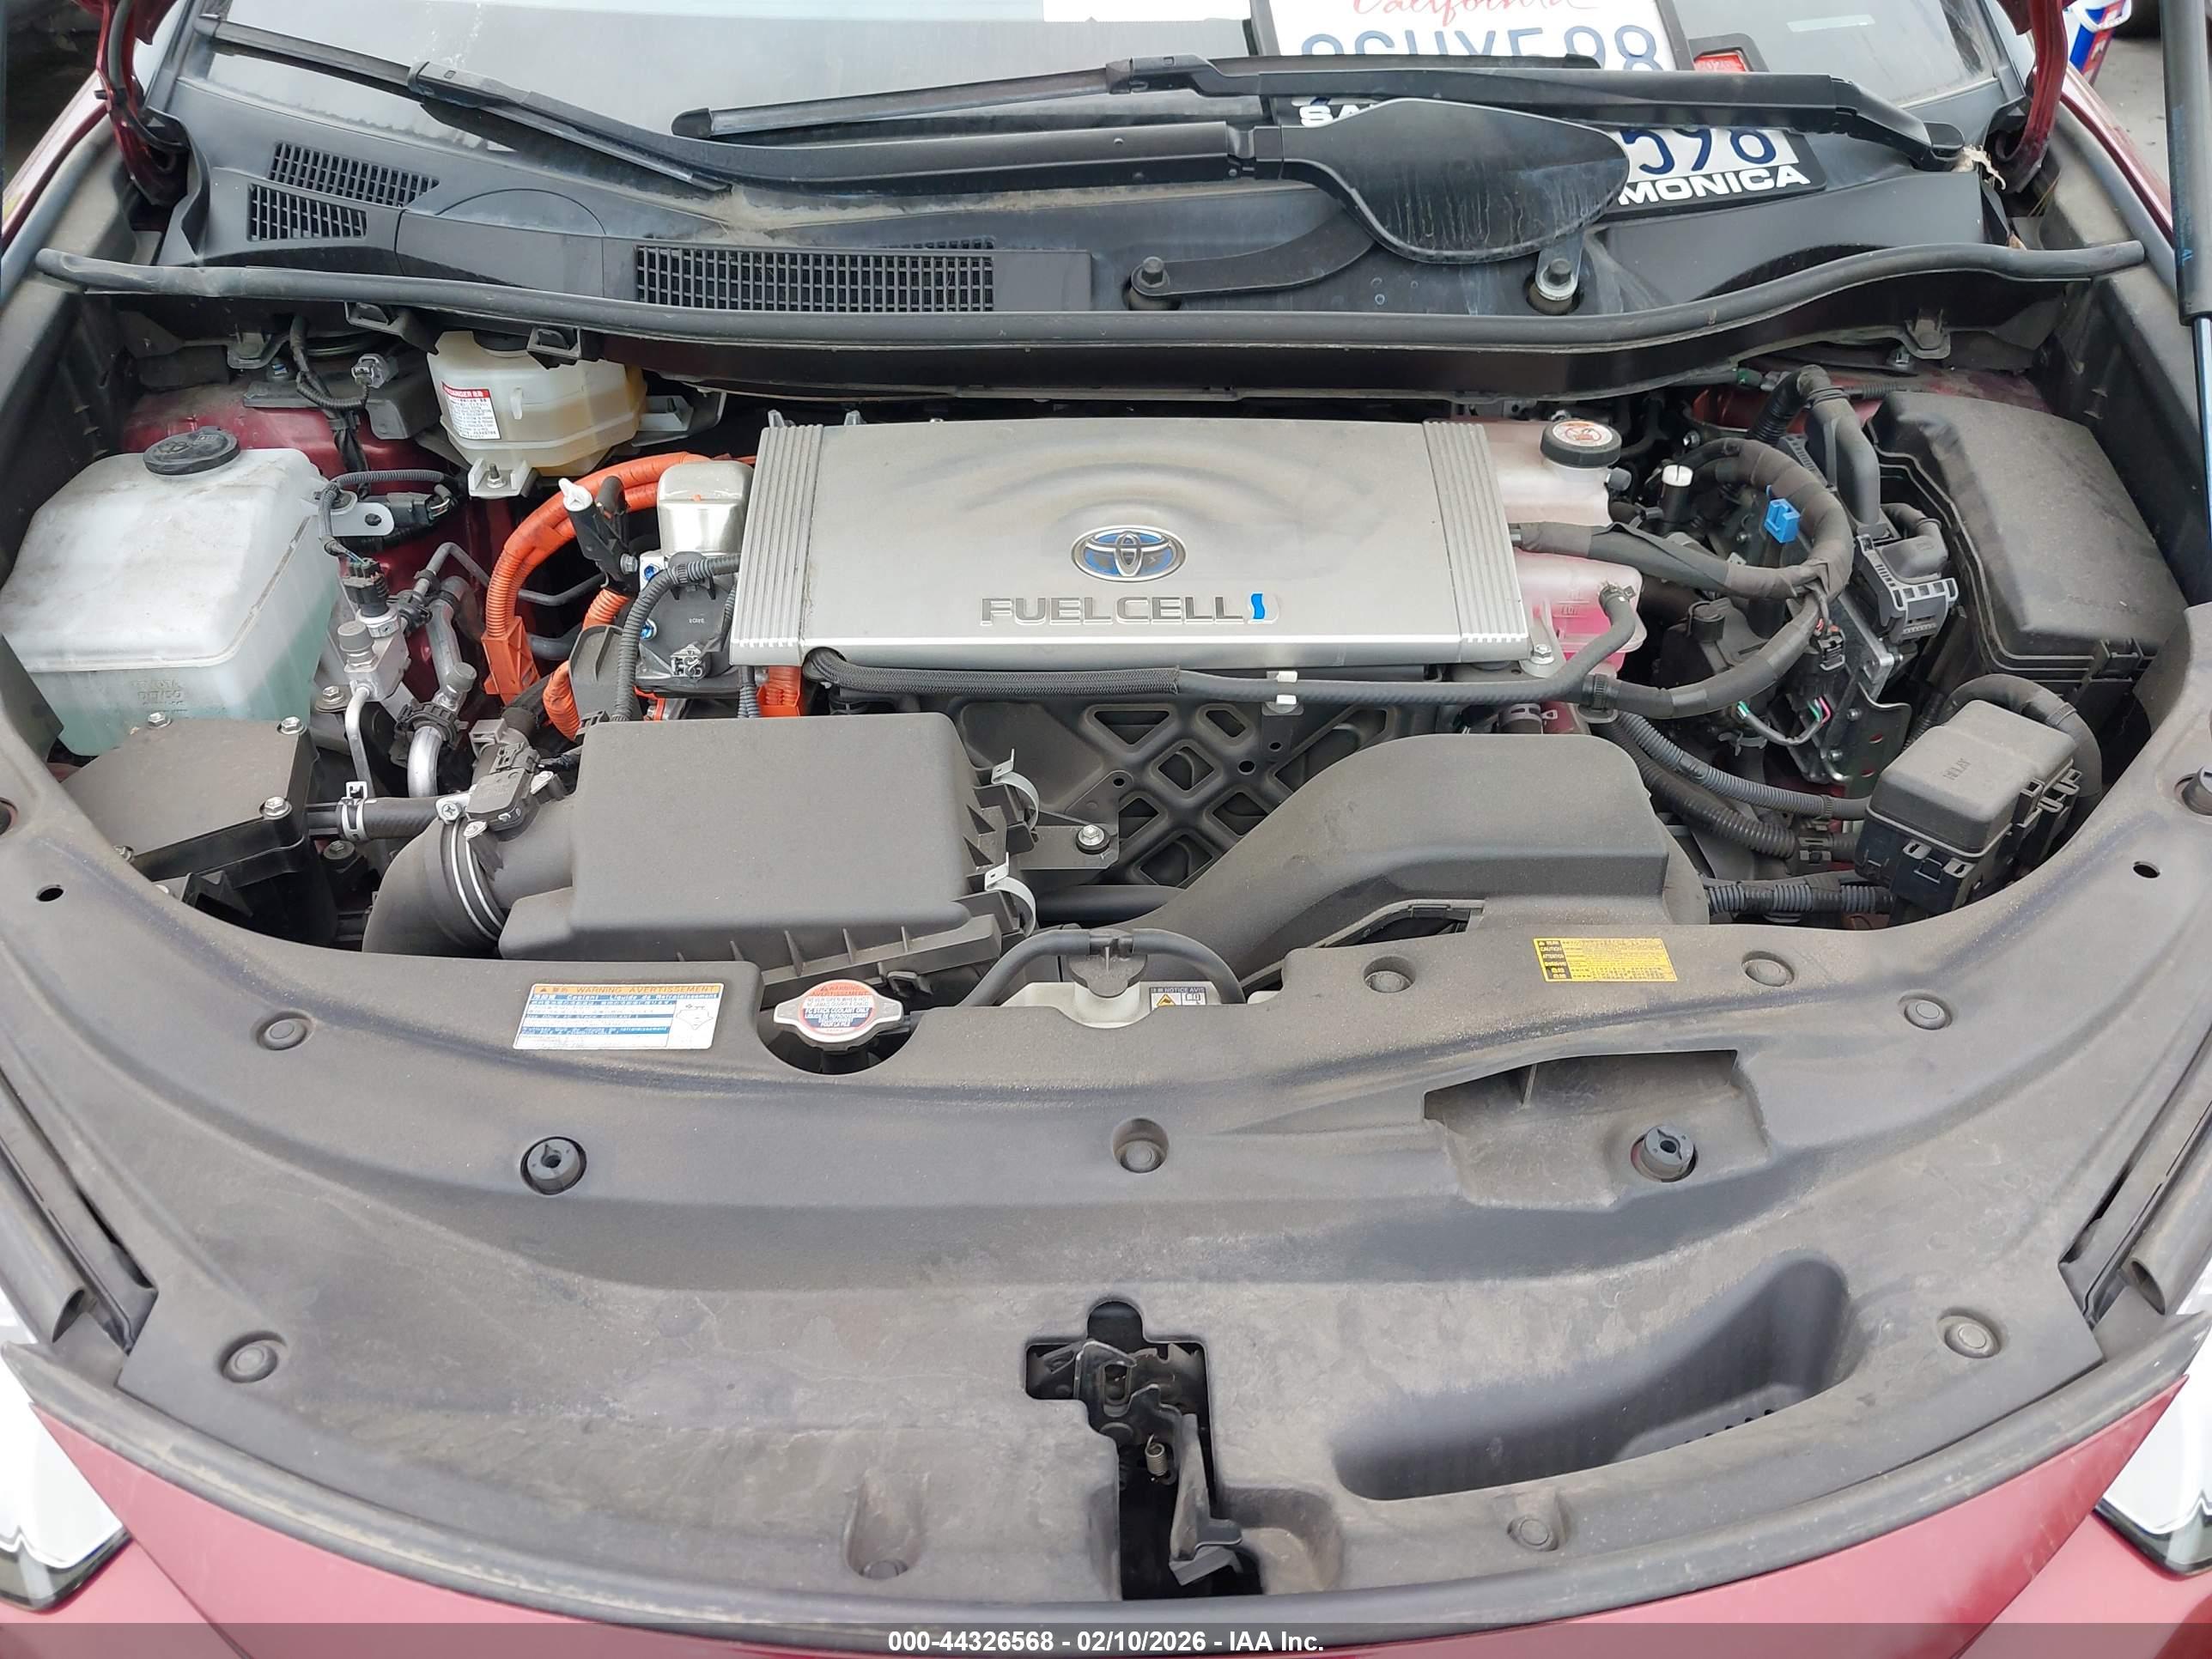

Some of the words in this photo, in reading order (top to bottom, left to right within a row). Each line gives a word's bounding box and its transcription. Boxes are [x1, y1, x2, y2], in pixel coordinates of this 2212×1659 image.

[1618, 165, 1810, 206] MONICA
[981, 597, 1112, 625] FUEL
[1116, 596, 1245, 625] CELL
